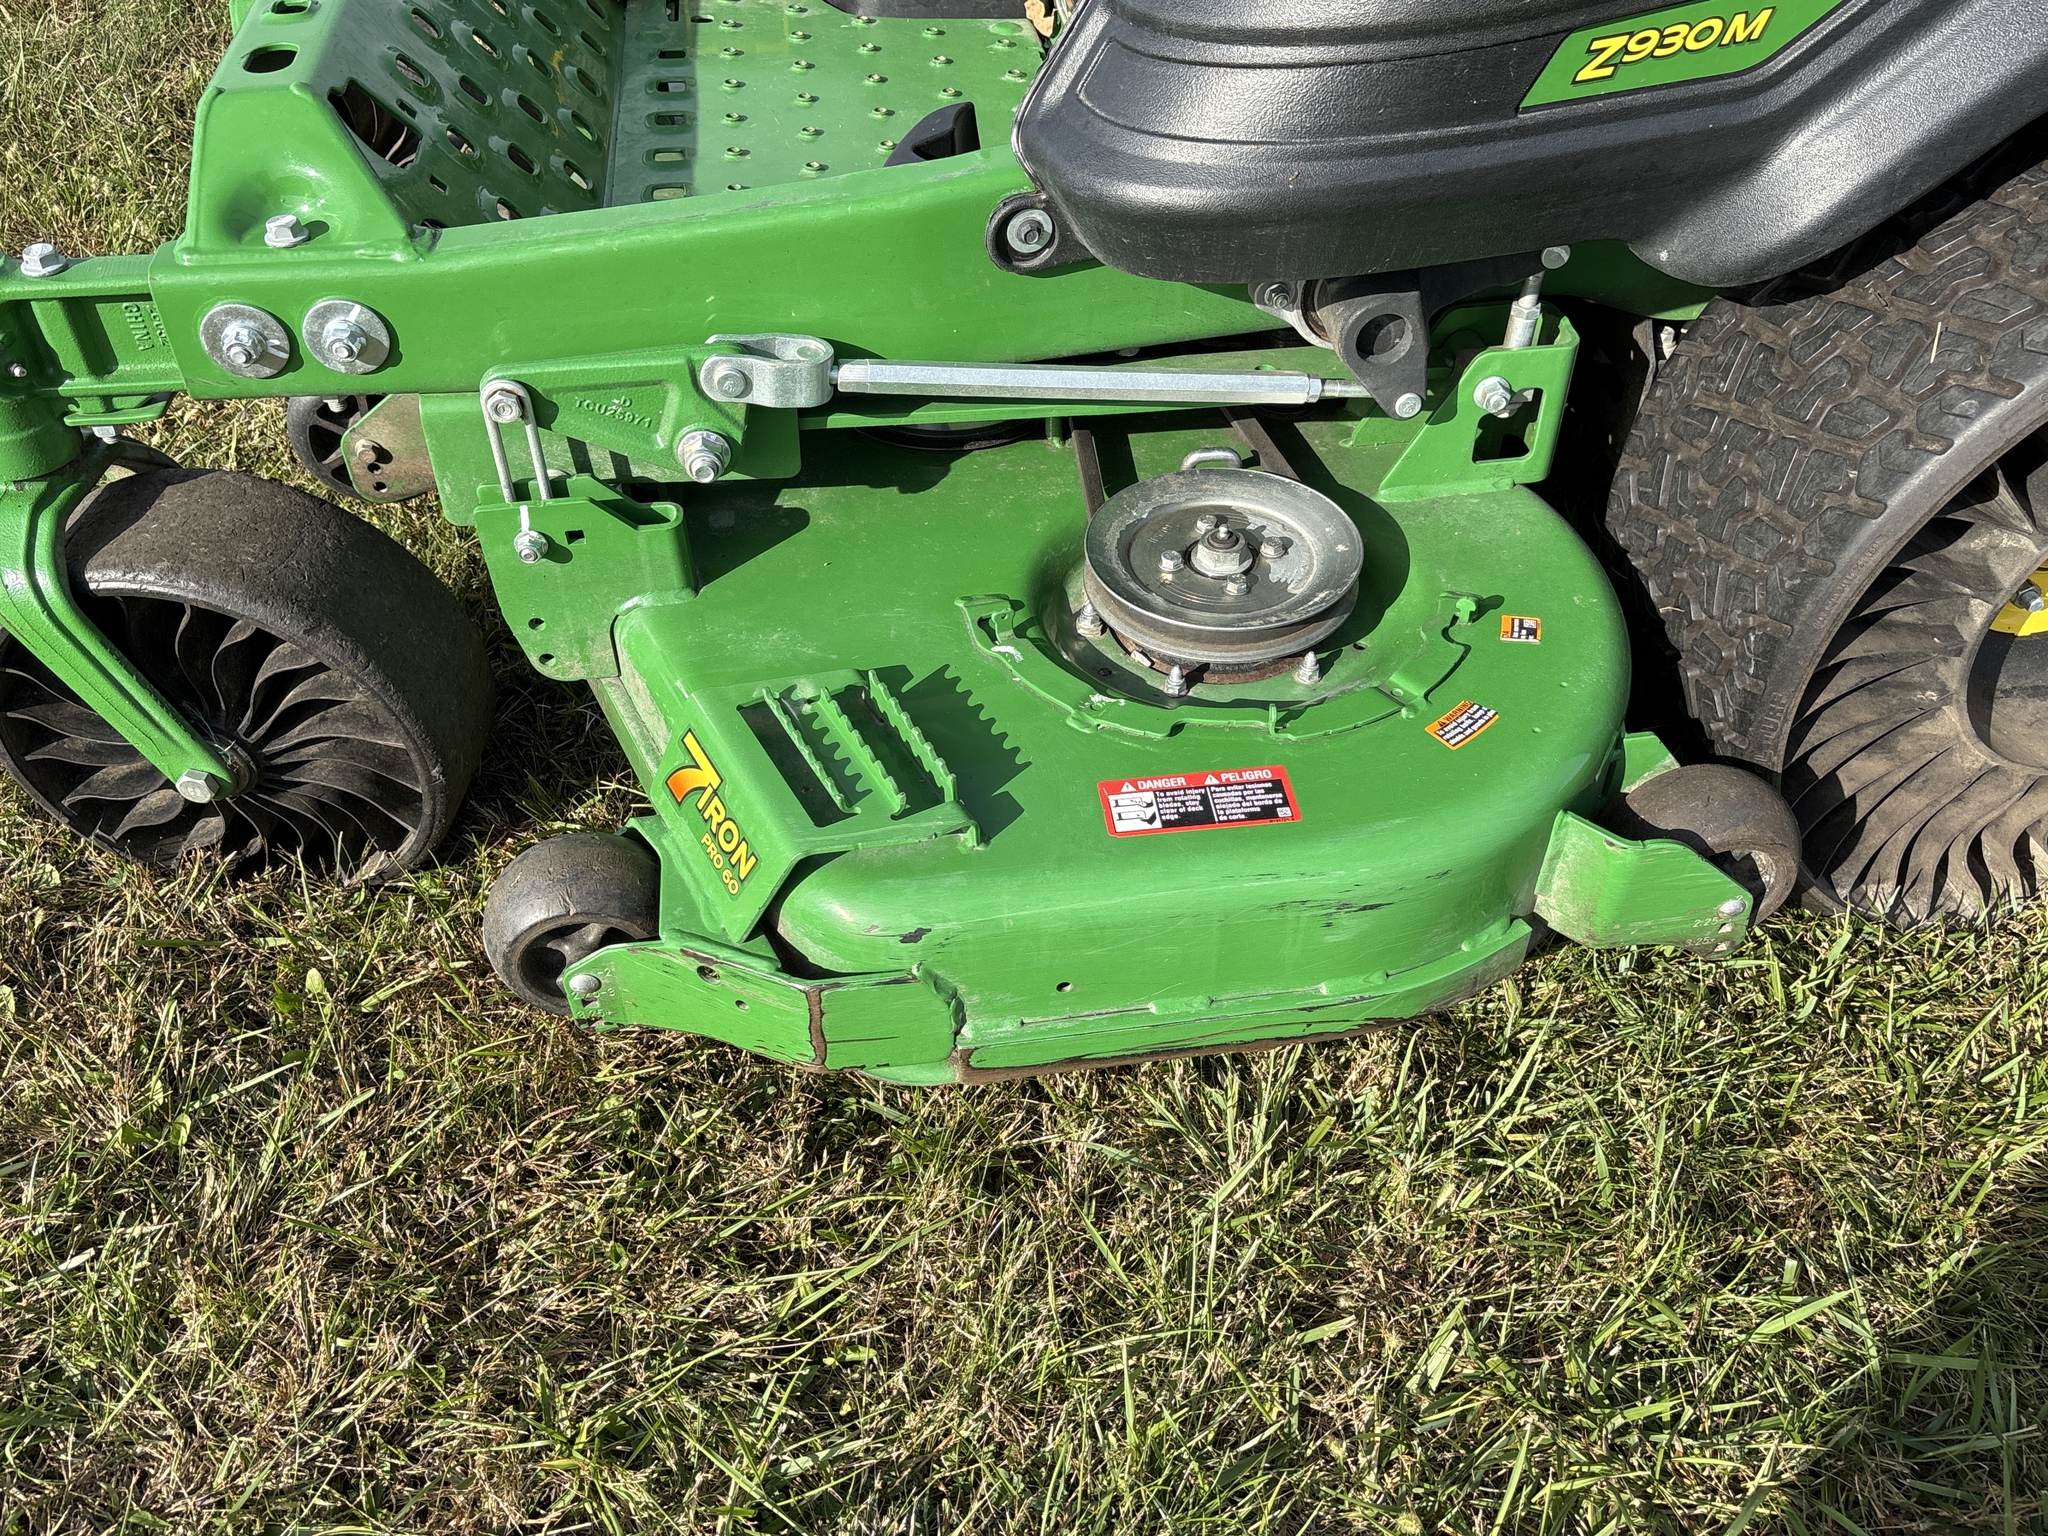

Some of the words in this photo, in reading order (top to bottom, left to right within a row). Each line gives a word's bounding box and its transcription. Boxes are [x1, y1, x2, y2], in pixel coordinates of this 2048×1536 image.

[1572, 7, 1776, 84] Z930M
[123, 303, 155, 351] CHINA
[1220, 769, 1272, 783] PELIGRO
[1137, 777, 1186, 790] DANGER
[1212, 790, 1242, 798] causadas
[1245, 793, 1283, 801] mantenerse
[666, 728, 758, 883] 7IRON
[1215, 801, 1241, 810] alejado
[1225, 806, 1261, 815] plataforma
[701, 832, 724, 870] PRO
[722, 868, 739, 895] 60
